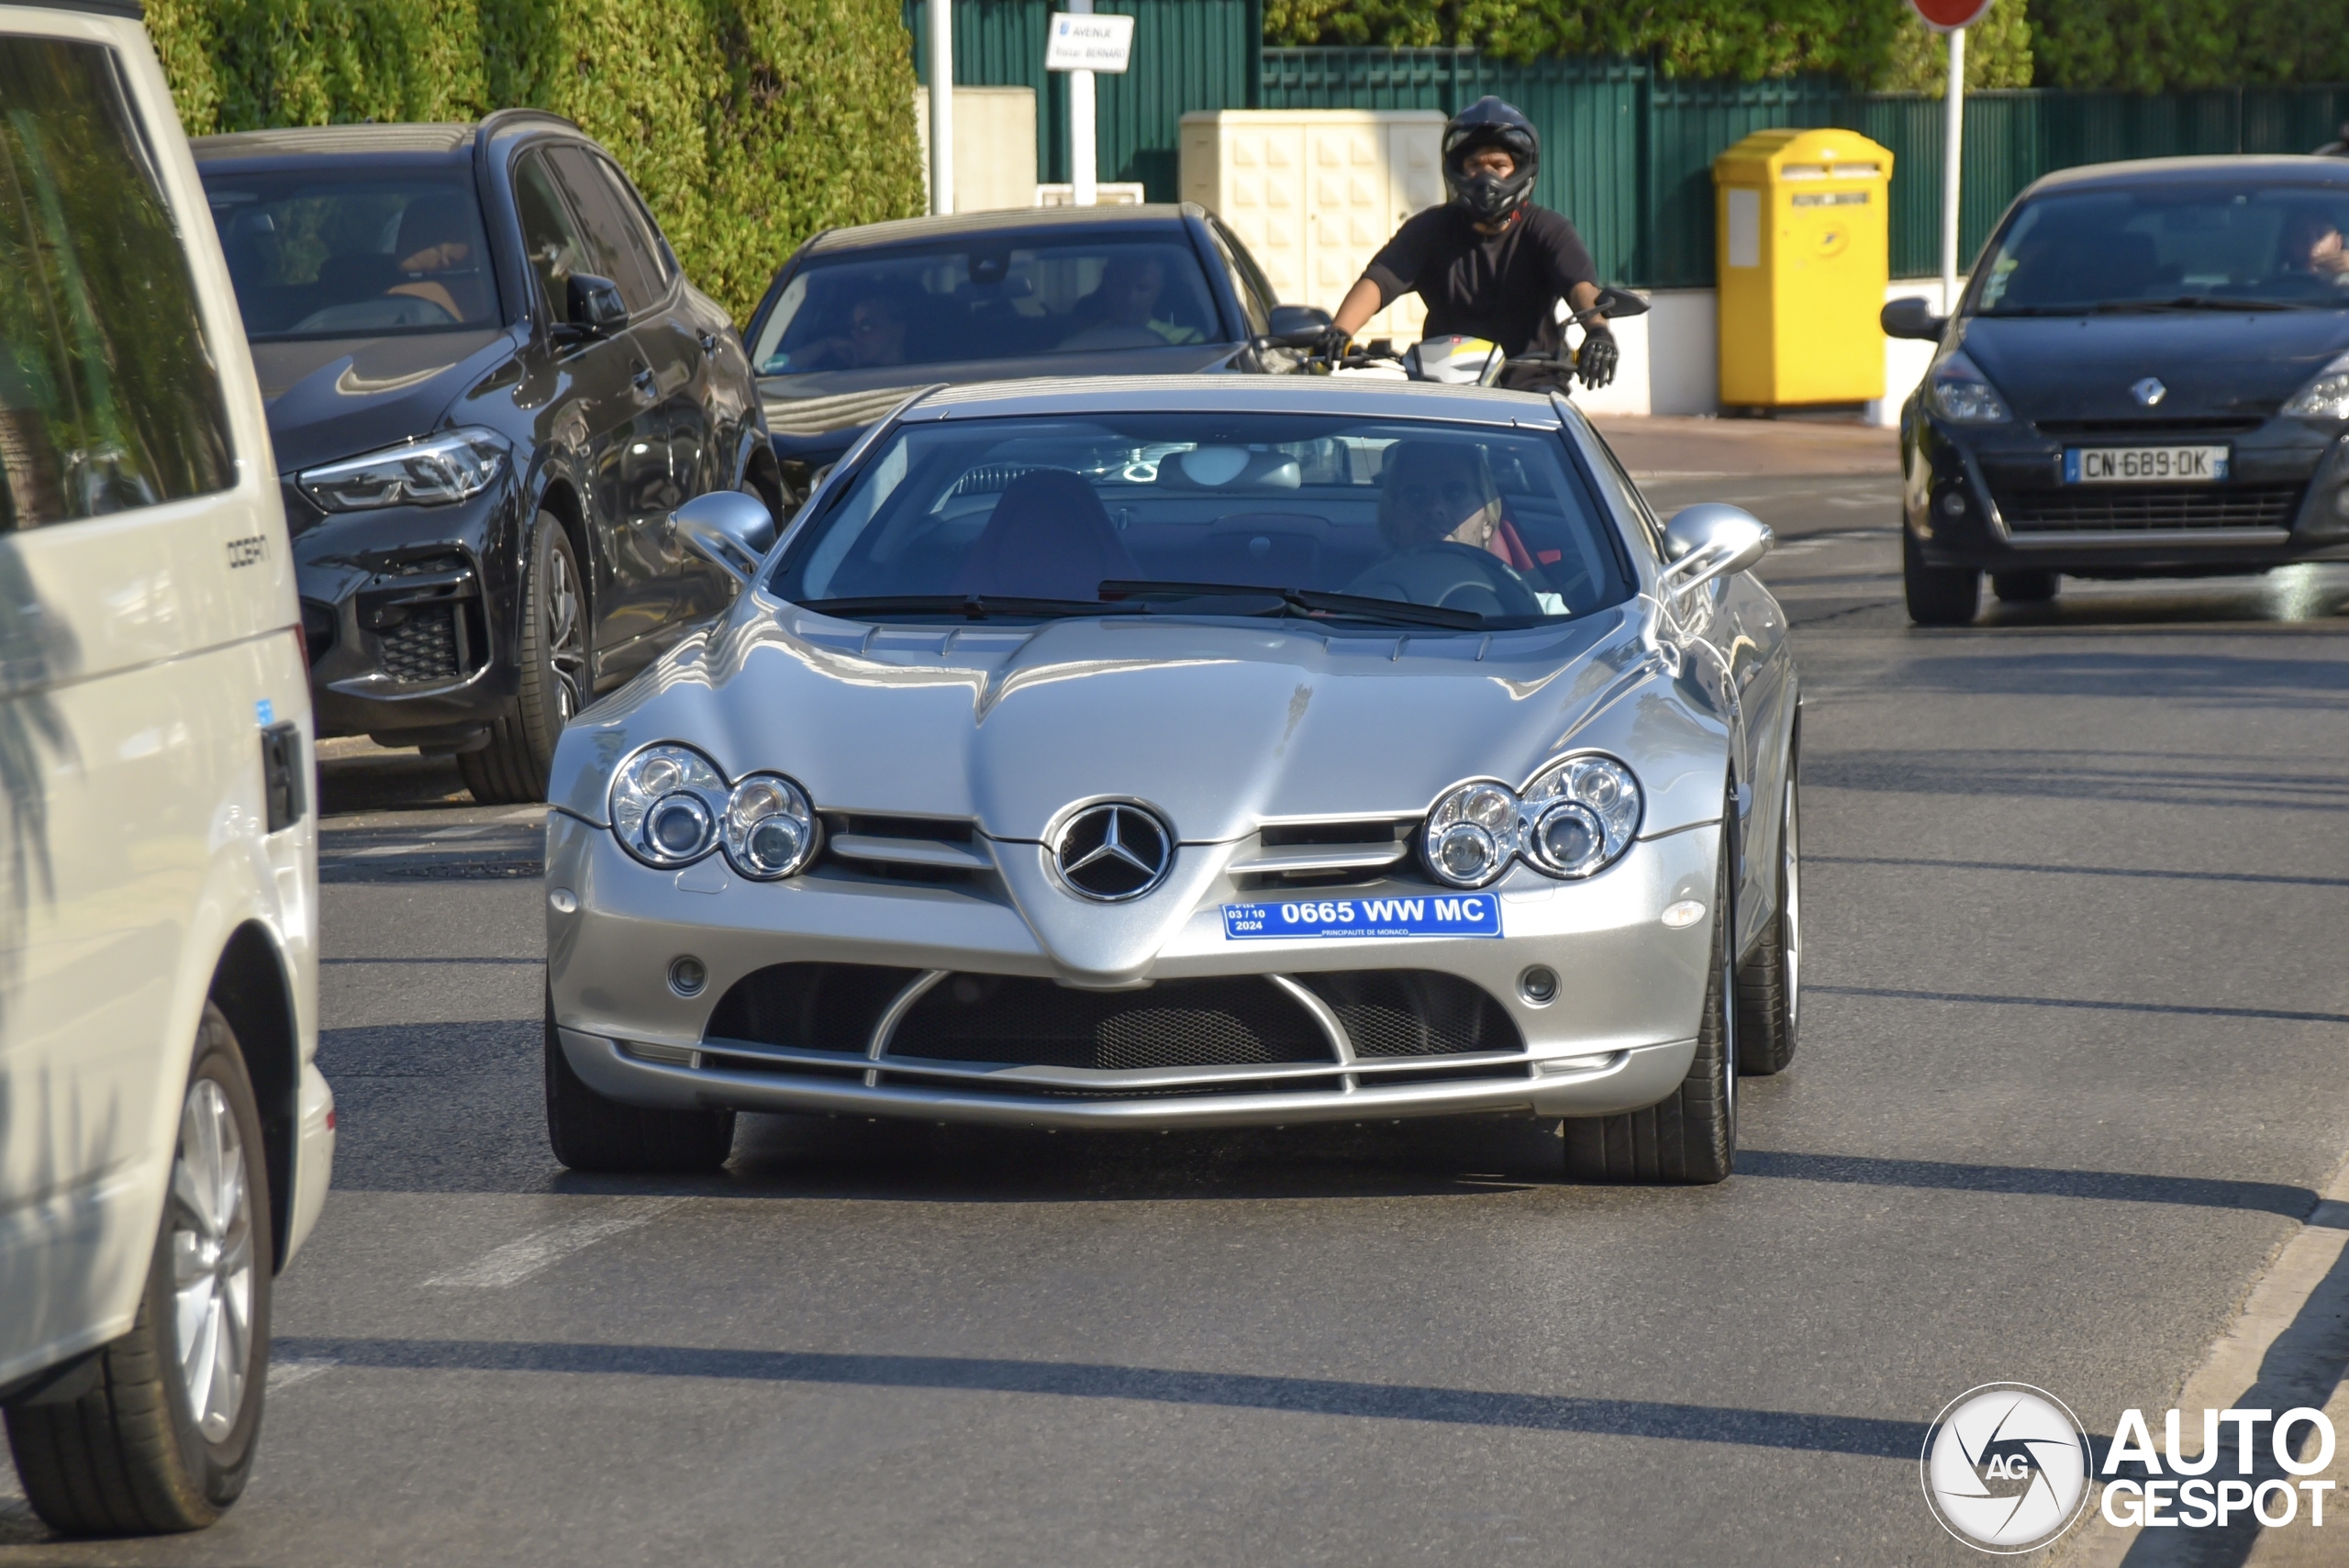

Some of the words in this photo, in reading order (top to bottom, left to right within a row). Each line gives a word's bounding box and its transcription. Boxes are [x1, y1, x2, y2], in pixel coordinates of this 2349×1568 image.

[1072, 26, 1113, 38] AVENUE
[1229, 910, 1242, 918] 03
[1252, 909, 1265, 918] 10
[1282, 902, 1355, 923] 0665
[1362, 899, 1424, 922] WW
[1434, 898, 1485, 921] MC
[1235, 921, 1263, 930] 2024
